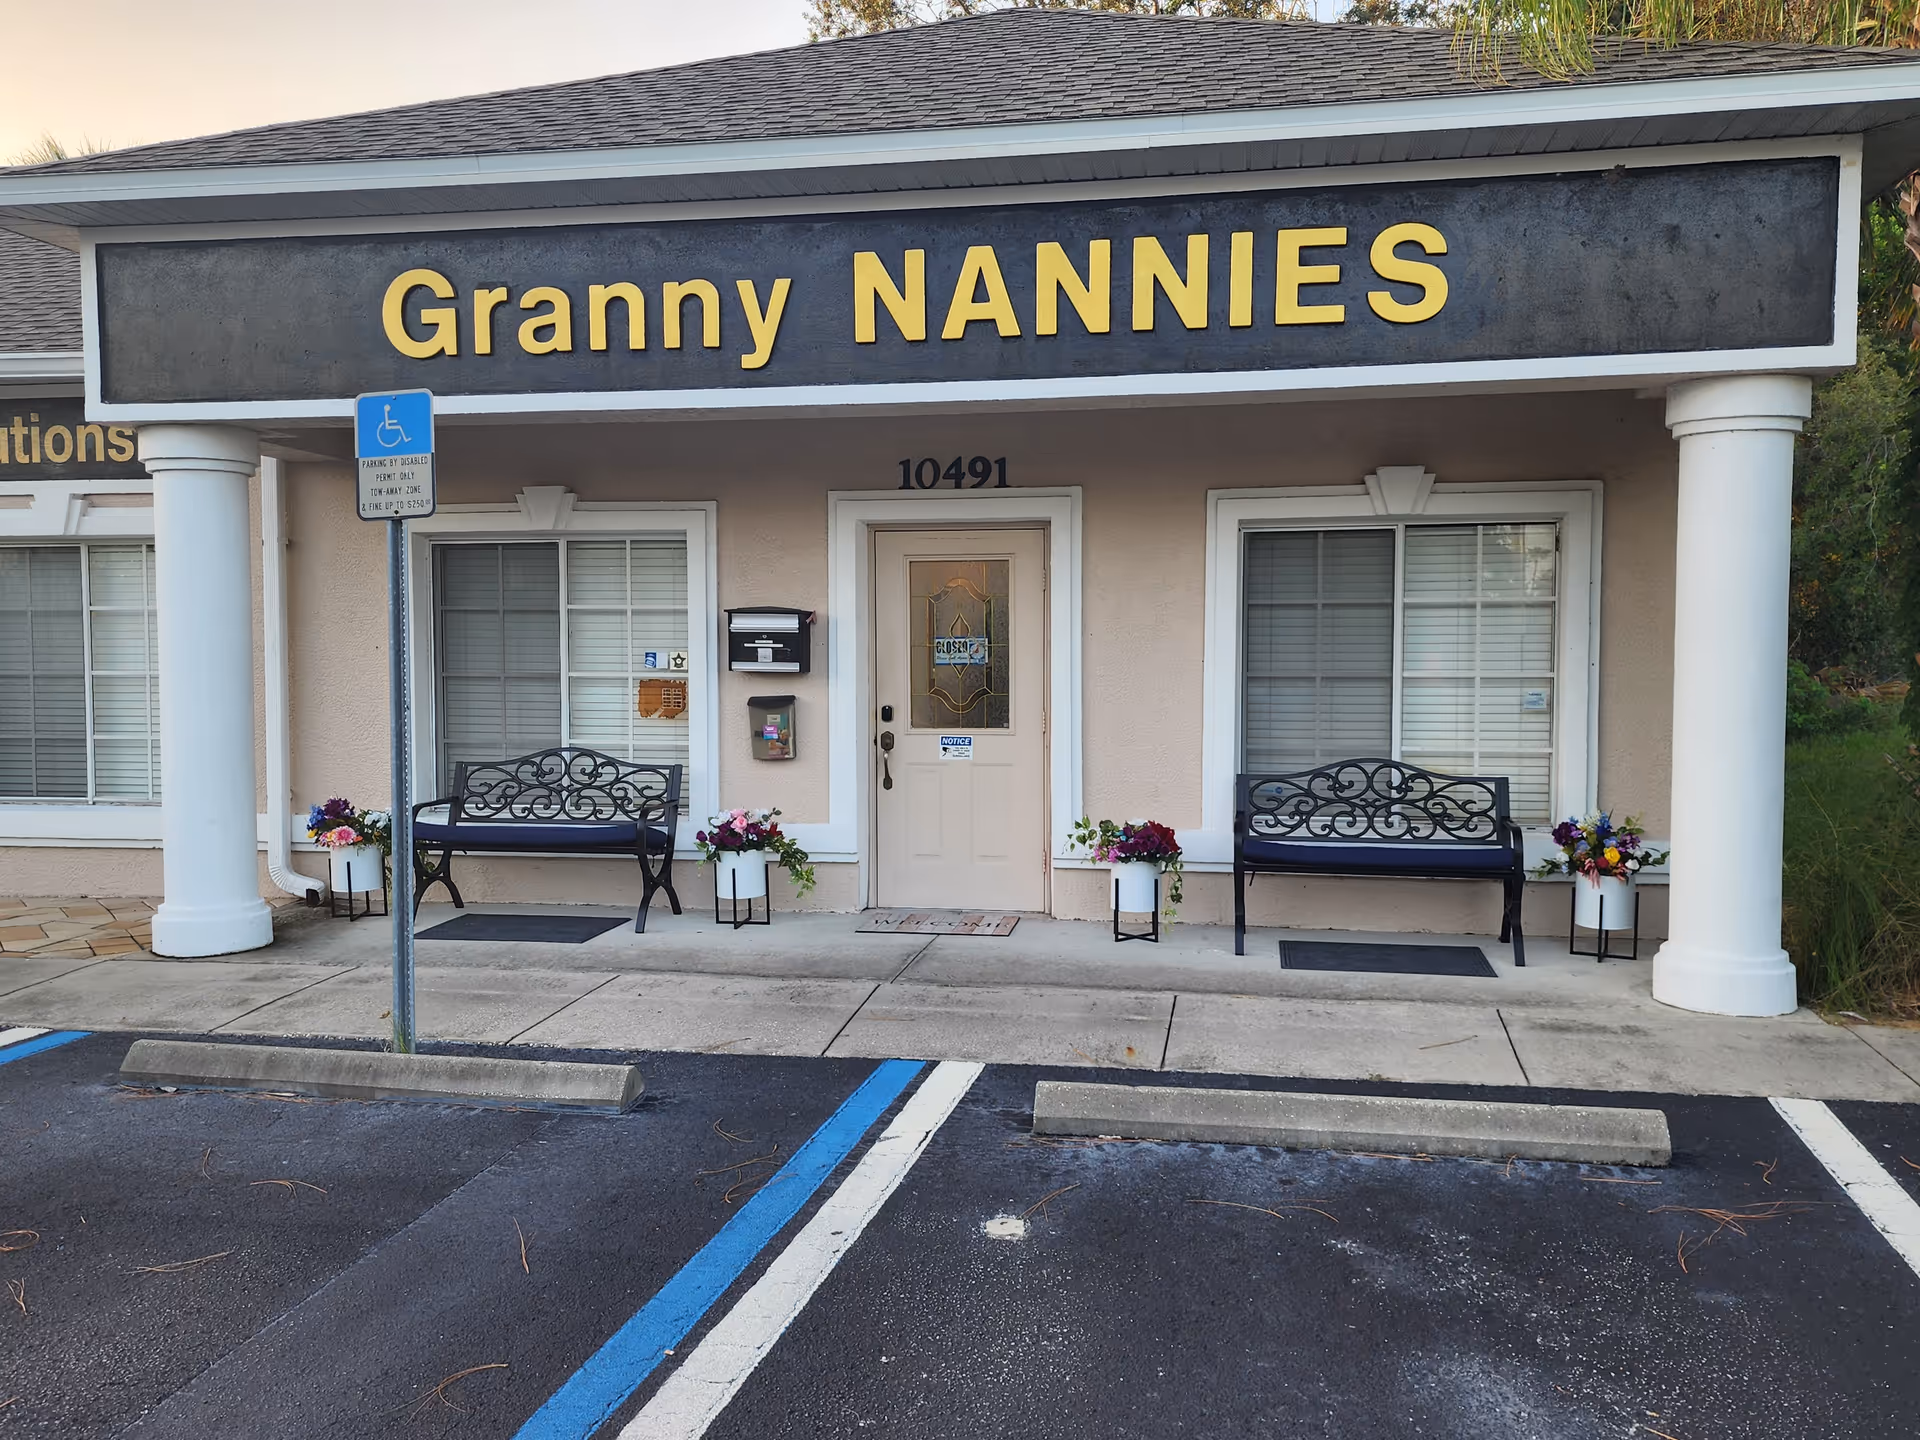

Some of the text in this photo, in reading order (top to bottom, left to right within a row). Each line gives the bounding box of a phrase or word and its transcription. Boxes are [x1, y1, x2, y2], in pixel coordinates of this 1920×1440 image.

[382, 222, 1449, 369] Granny NANNIES
[362, 456, 428, 469] PARKING BY DISABLED
[375, 471, 415, 482] PERMIT ONLY
[898, 455, 1012, 490] 10491
[370, 485, 421, 497] TOW-AWAY ZONE
[361, 503, 366, 512] &
[369, 502, 382, 511] FINE
[385, 501, 393, 510] UP
[396, 500, 404, 509] TO
[936, 640, 968, 654] CLOSED
[941, 737, 971, 745] NOTICE
